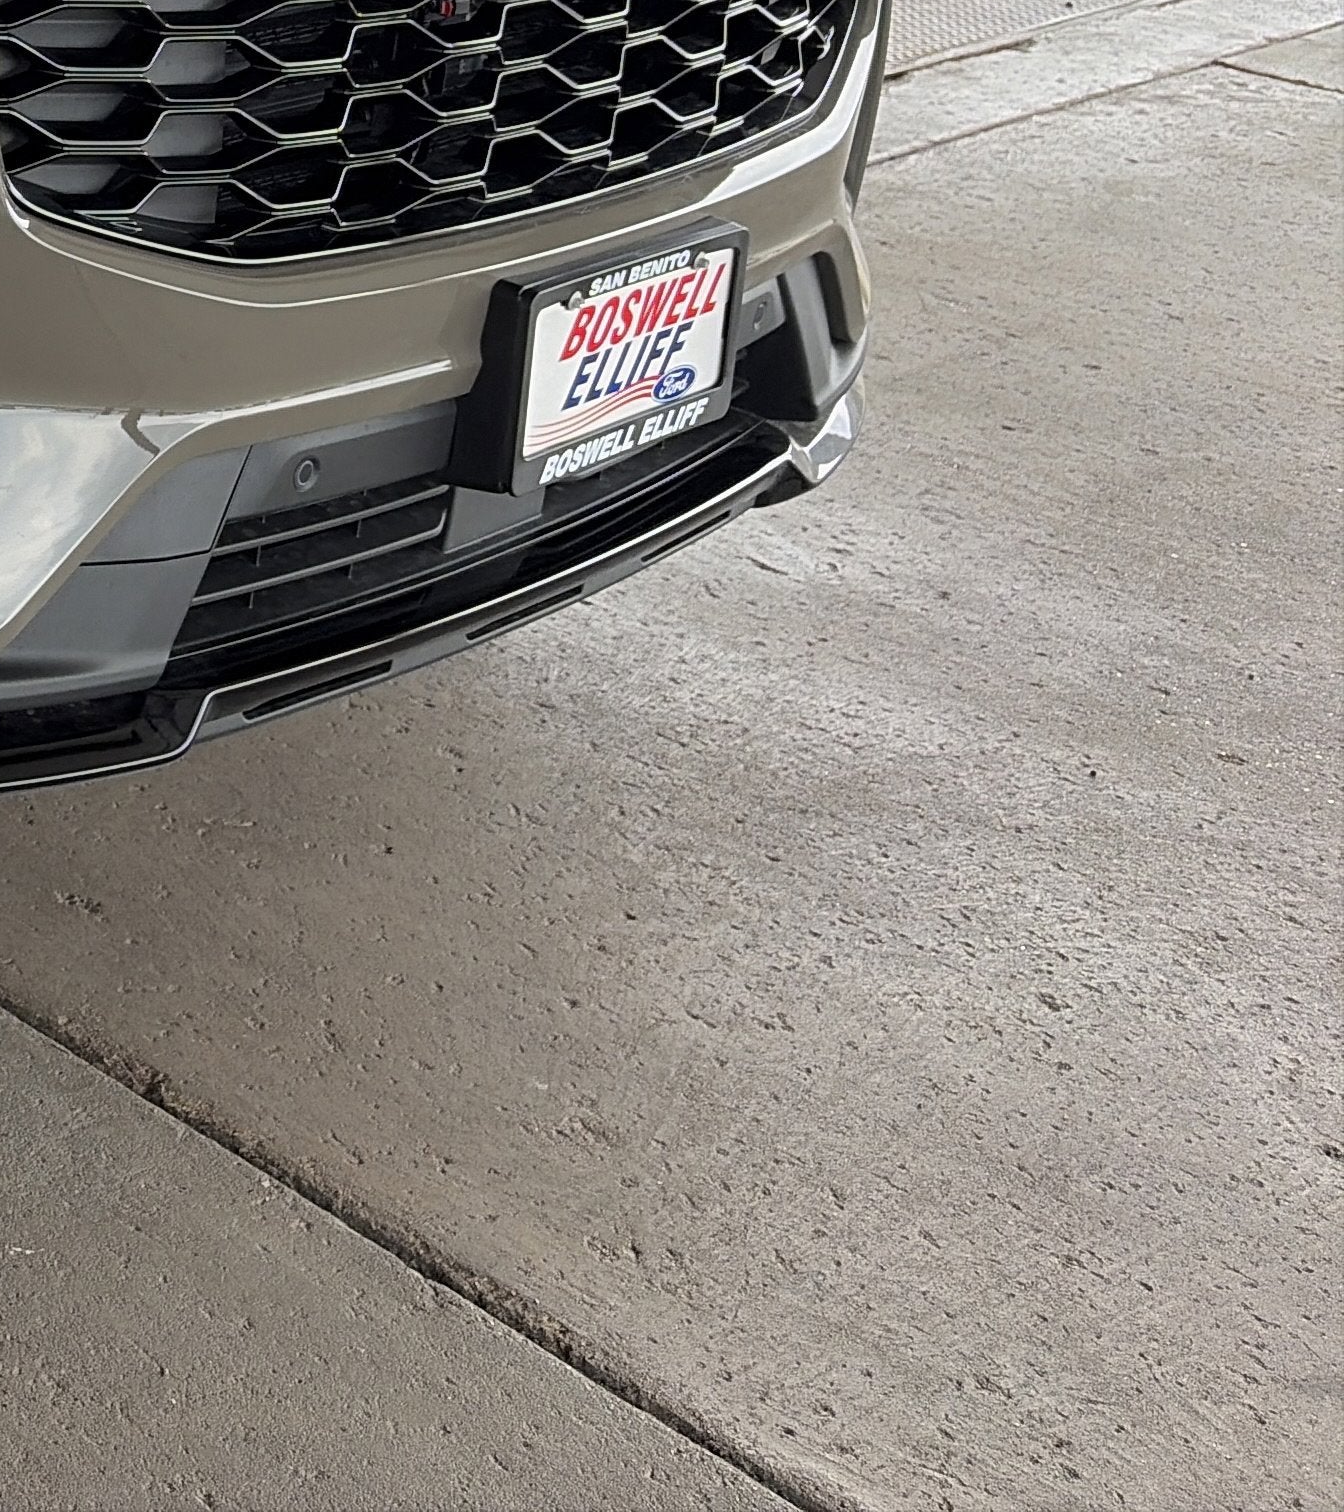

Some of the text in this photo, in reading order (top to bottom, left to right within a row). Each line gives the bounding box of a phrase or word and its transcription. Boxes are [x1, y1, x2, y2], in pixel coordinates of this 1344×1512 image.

[559, 263, 726, 362] BOSWELL
[588, 249, 691, 296] SAN BENITO
[561, 321, 694, 412] ELLIFF
[657, 371, 692, 400] Ford
[539, 397, 710, 486] BOSWELL ELLIFF
